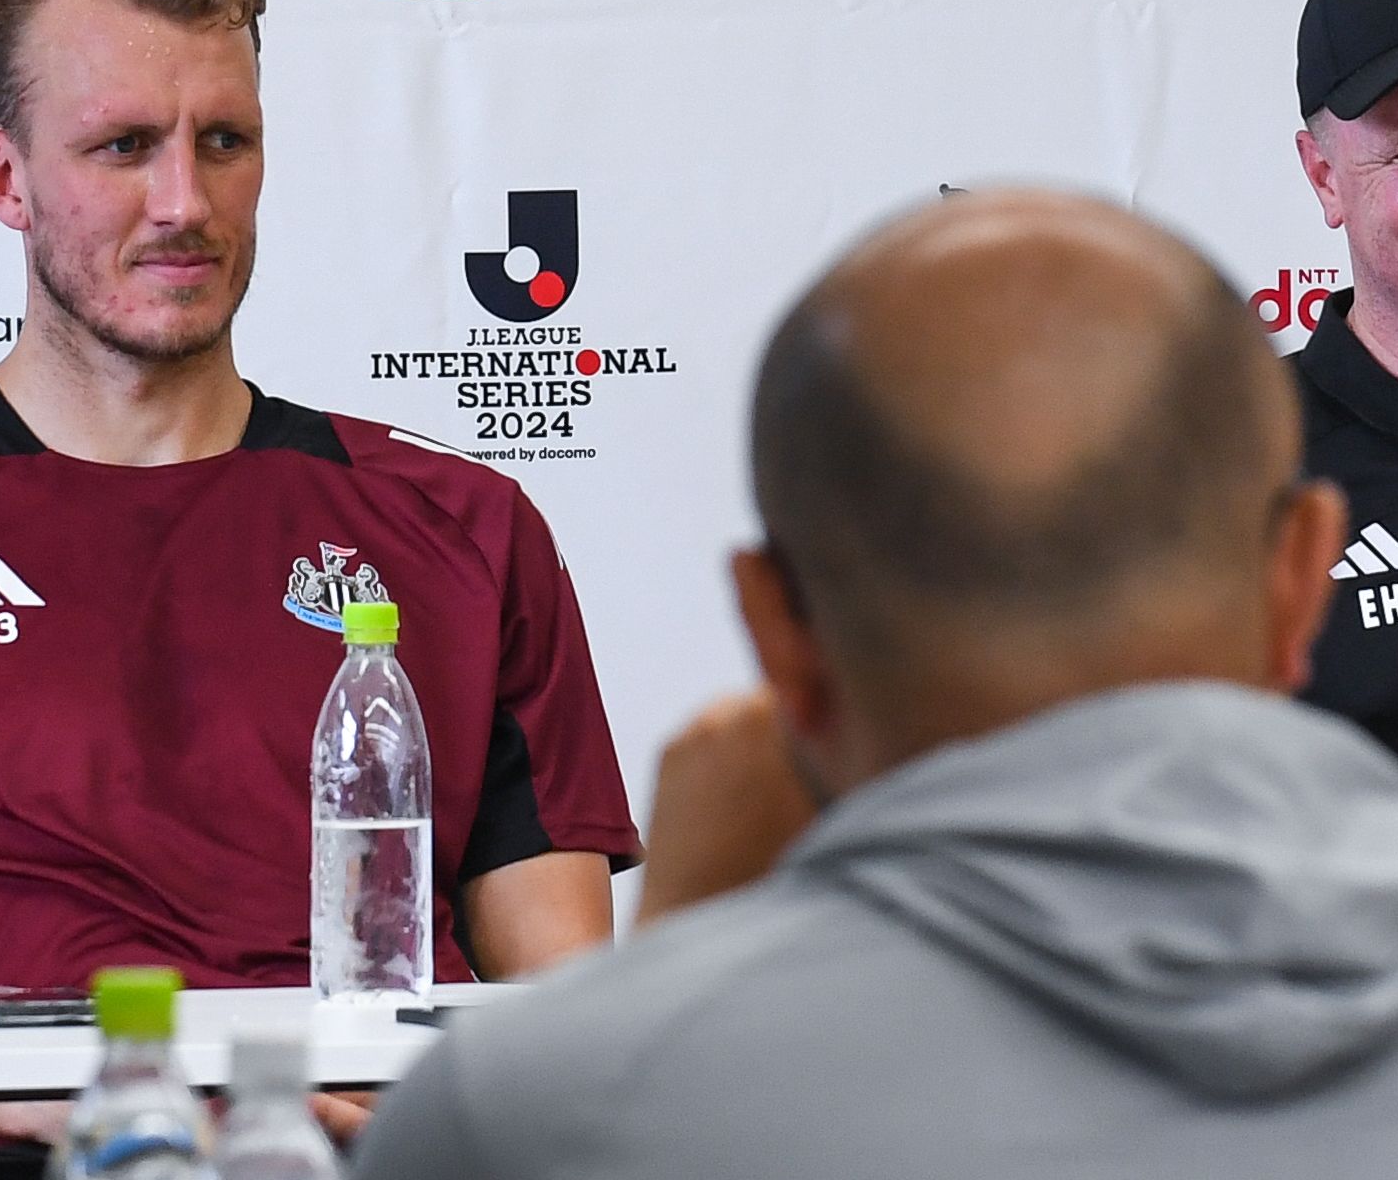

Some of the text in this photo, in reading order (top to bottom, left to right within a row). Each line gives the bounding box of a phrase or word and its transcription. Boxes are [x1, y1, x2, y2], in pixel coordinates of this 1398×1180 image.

[1298, 269, 1340, 284] NTT
[466, 326, 582, 347] J.LEAGUE
[371, 347, 678, 379] INTERNATIONAL
[457, 380, 592, 409] SERIES
[476, 411, 575, 440] 2024
[519, 447, 536, 462] by
[538, 446, 597, 459] docomo
